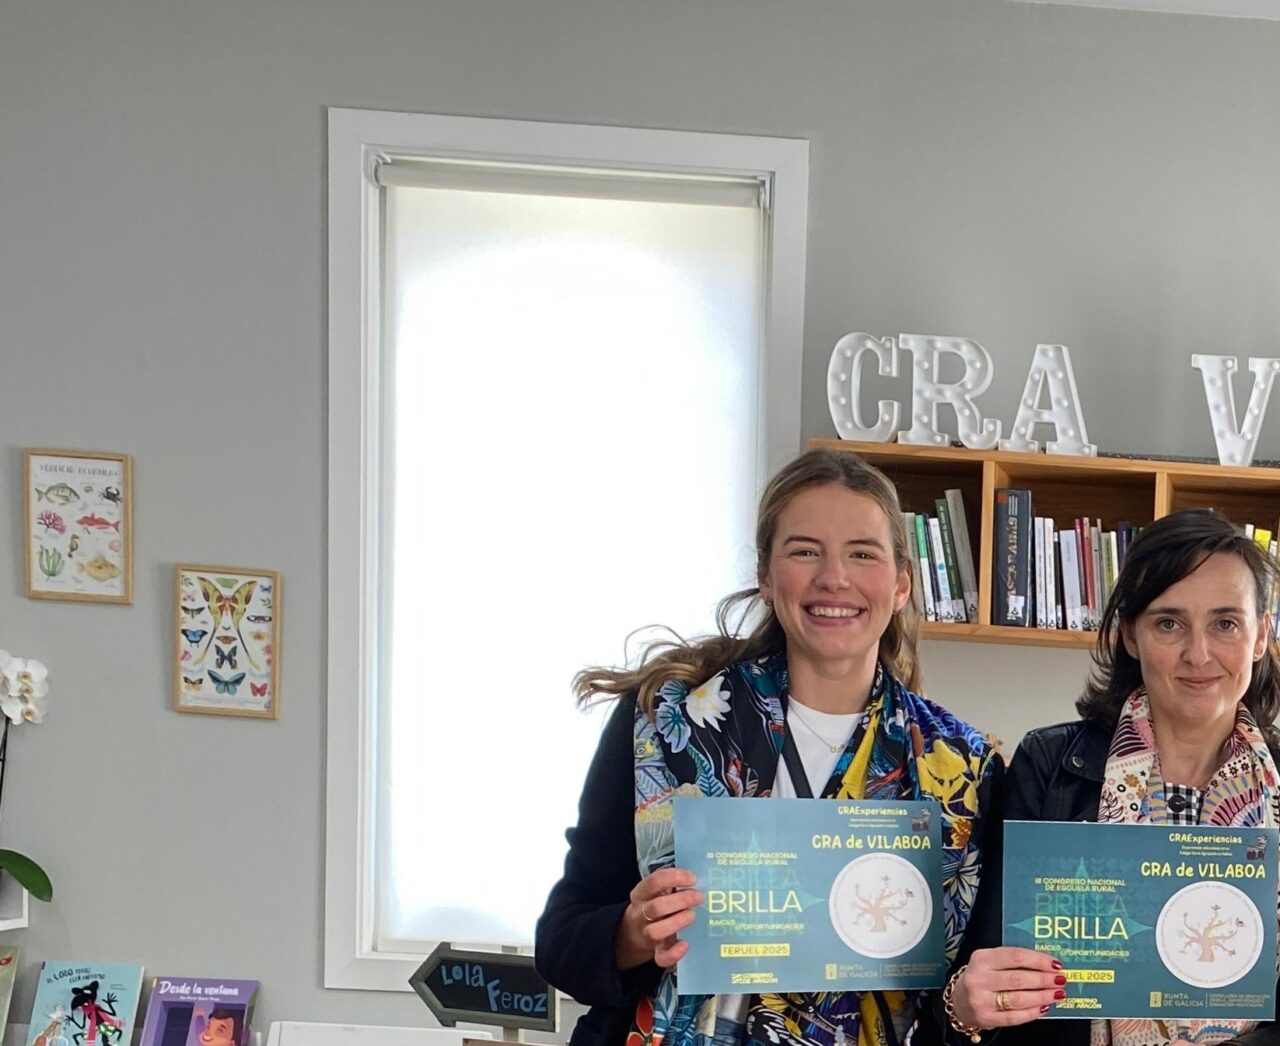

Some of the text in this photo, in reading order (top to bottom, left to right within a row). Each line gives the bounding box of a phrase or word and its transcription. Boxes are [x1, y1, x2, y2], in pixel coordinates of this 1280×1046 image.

[827, 332, 1097, 457] CRA
[838, 806, 908, 817] CRAExperiencias
[812, 834, 931, 850] CRA de VILABOA
[1169, 833, 1242, 845] CRAExperiencias
[1141, 862, 1266, 879] CRA de VILABOA
[708, 890, 803, 914] BRILLA
[1034, 915, 1129, 939] BRILLA
[723, 946, 789, 955] TERUEL 2025
[441, 962, 485, 988] Lola
[1087, 972, 1113, 980] 2025
[159, 981, 239, 996] Desde la ventana
[486, 979, 548, 1012] Feroz
